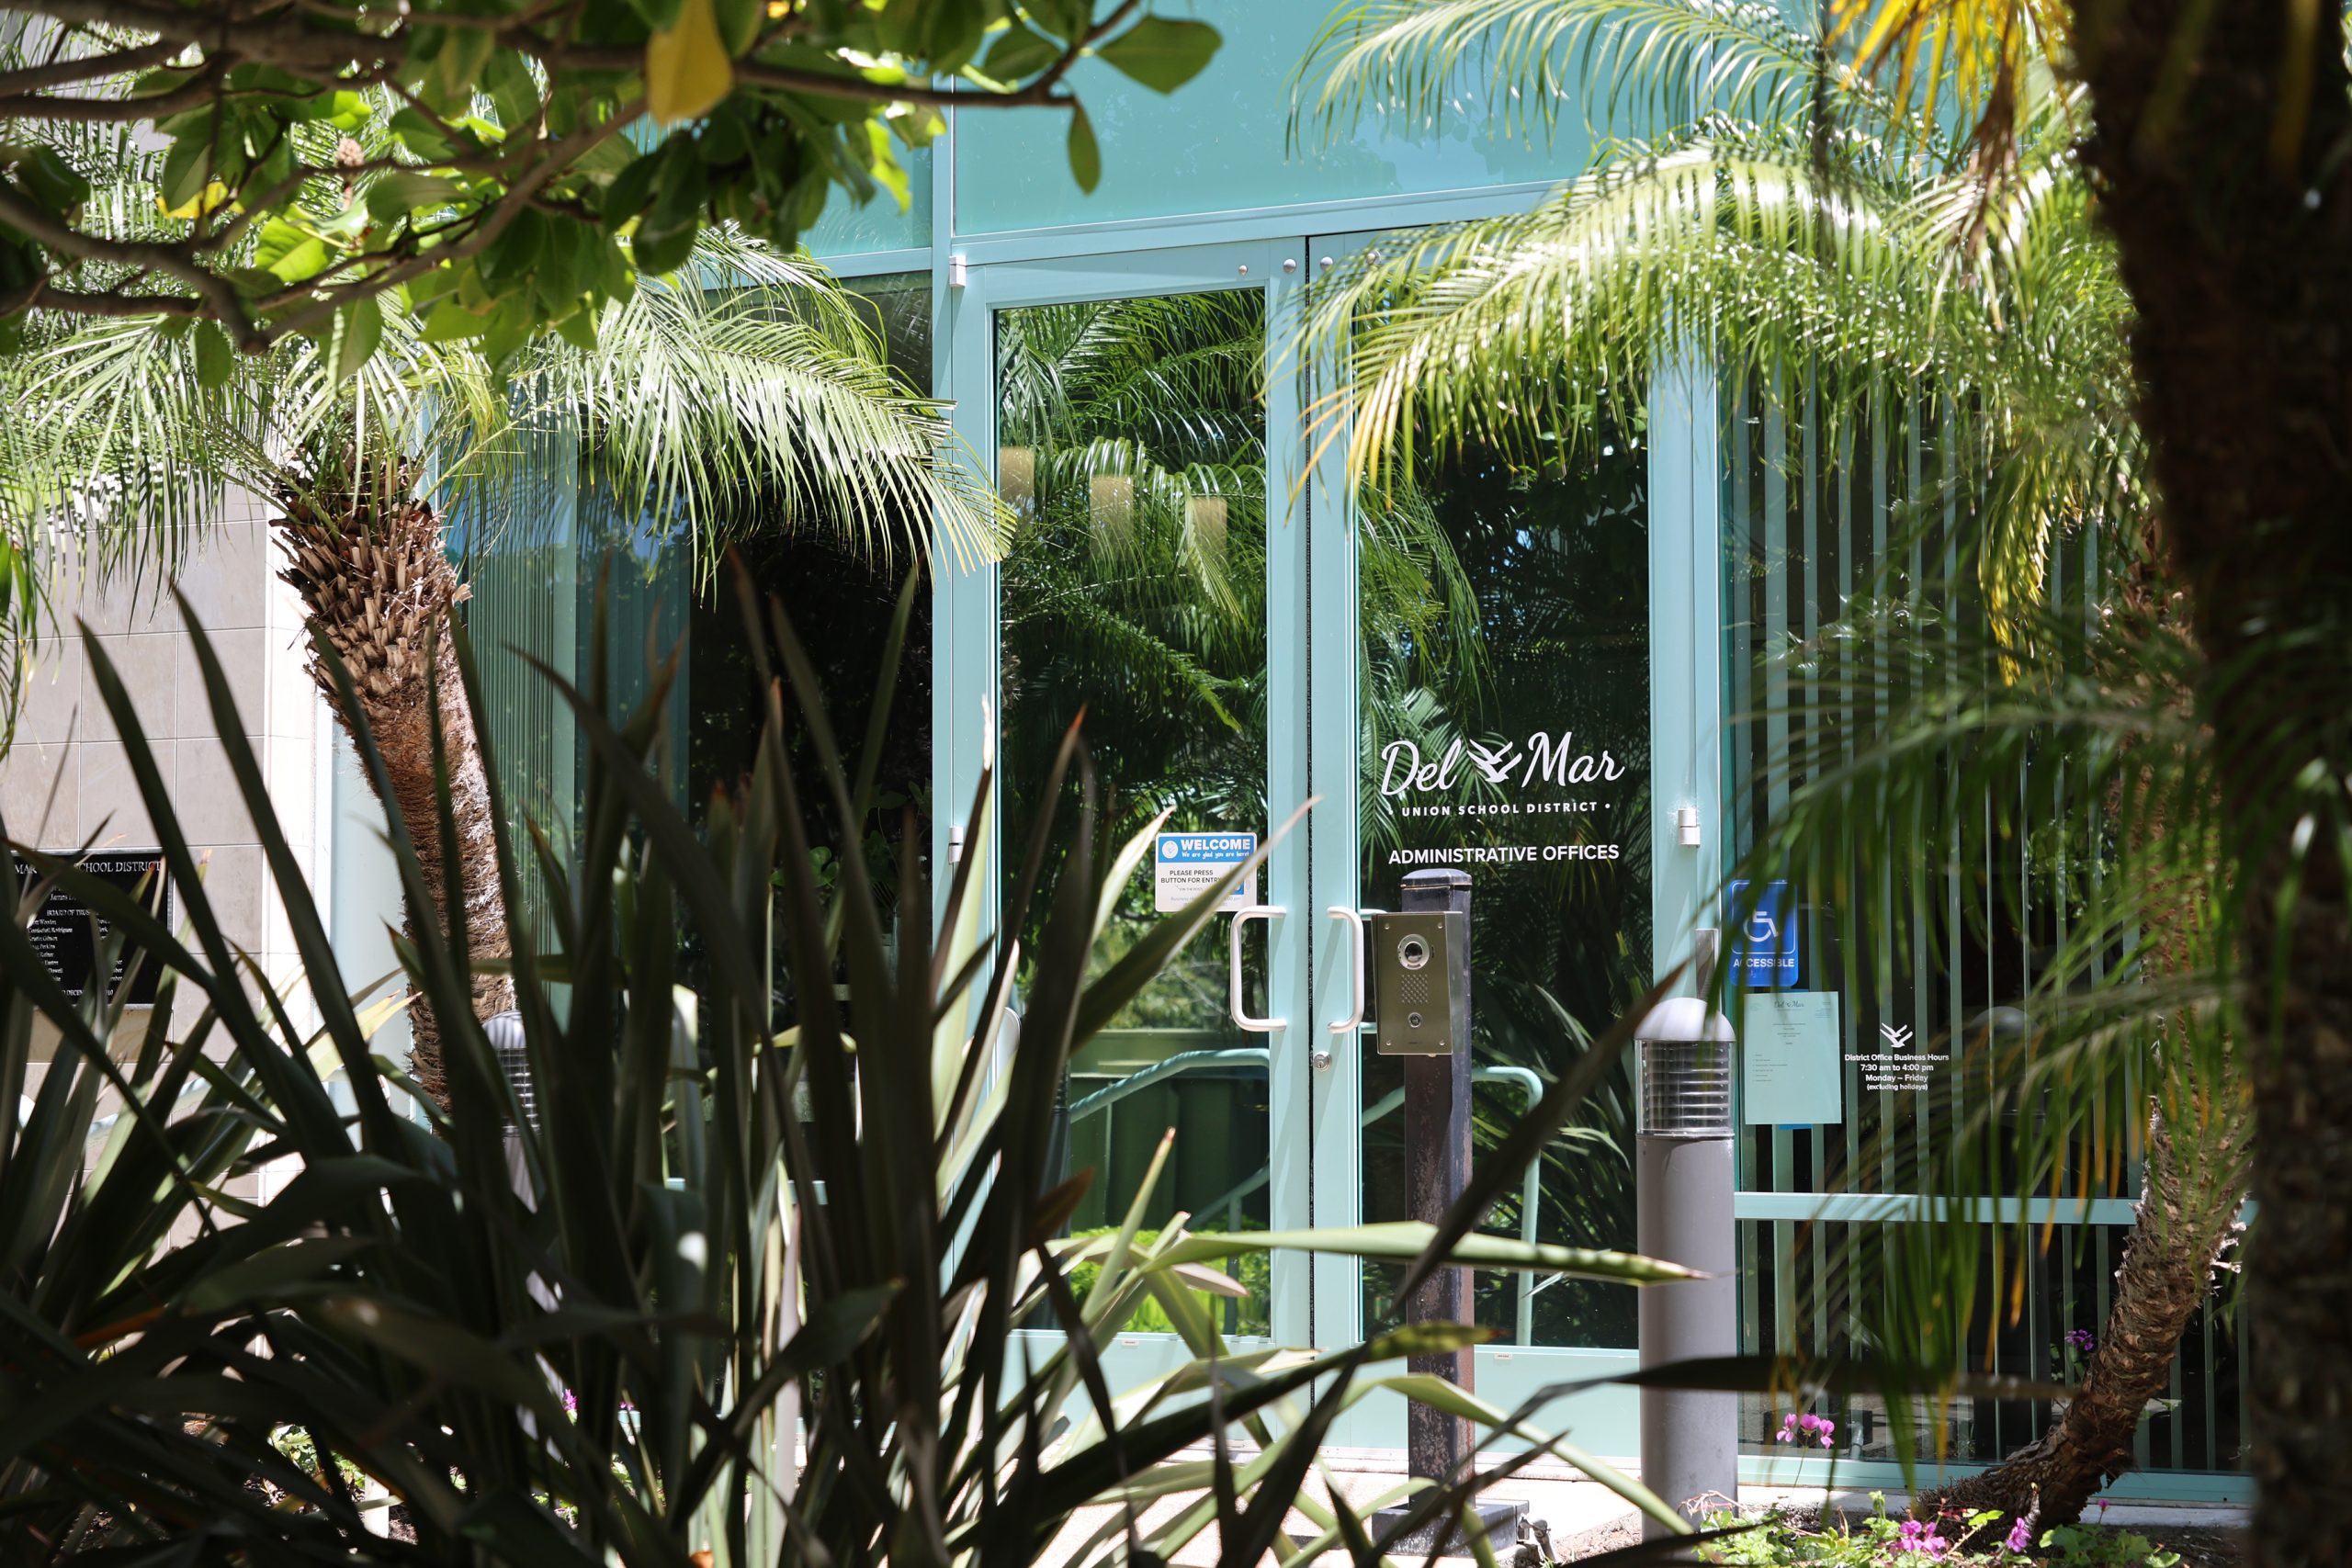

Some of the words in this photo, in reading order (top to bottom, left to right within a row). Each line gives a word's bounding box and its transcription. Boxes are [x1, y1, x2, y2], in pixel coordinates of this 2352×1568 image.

[1381, 739, 1462, 795] Del
[1521, 731, 1626, 788] Mar
[1402, 806, 1451, 817] UNION
[1458, 804, 1519, 816] SCHOOL
[1526, 801, 1598, 814] DISTRICT
[1181, 838, 1250, 851] WELCOME
[1203, 851, 1213, 860] glad
[1388, 846, 1537, 864] ADMINISTRATIVE
[1543, 844, 1620, 861] OFFICES
[78, 862, 113, 873] CHOOL
[1733, 958, 1794, 967] ACESSIBLE
[1865, 1074, 1896, 1083] Monday
[1905, 1074, 1928, 1083] Friday
[1866, 1083, 1899, 1091] (excluding
[1899, 1083, 1928, 1091] holidays)
